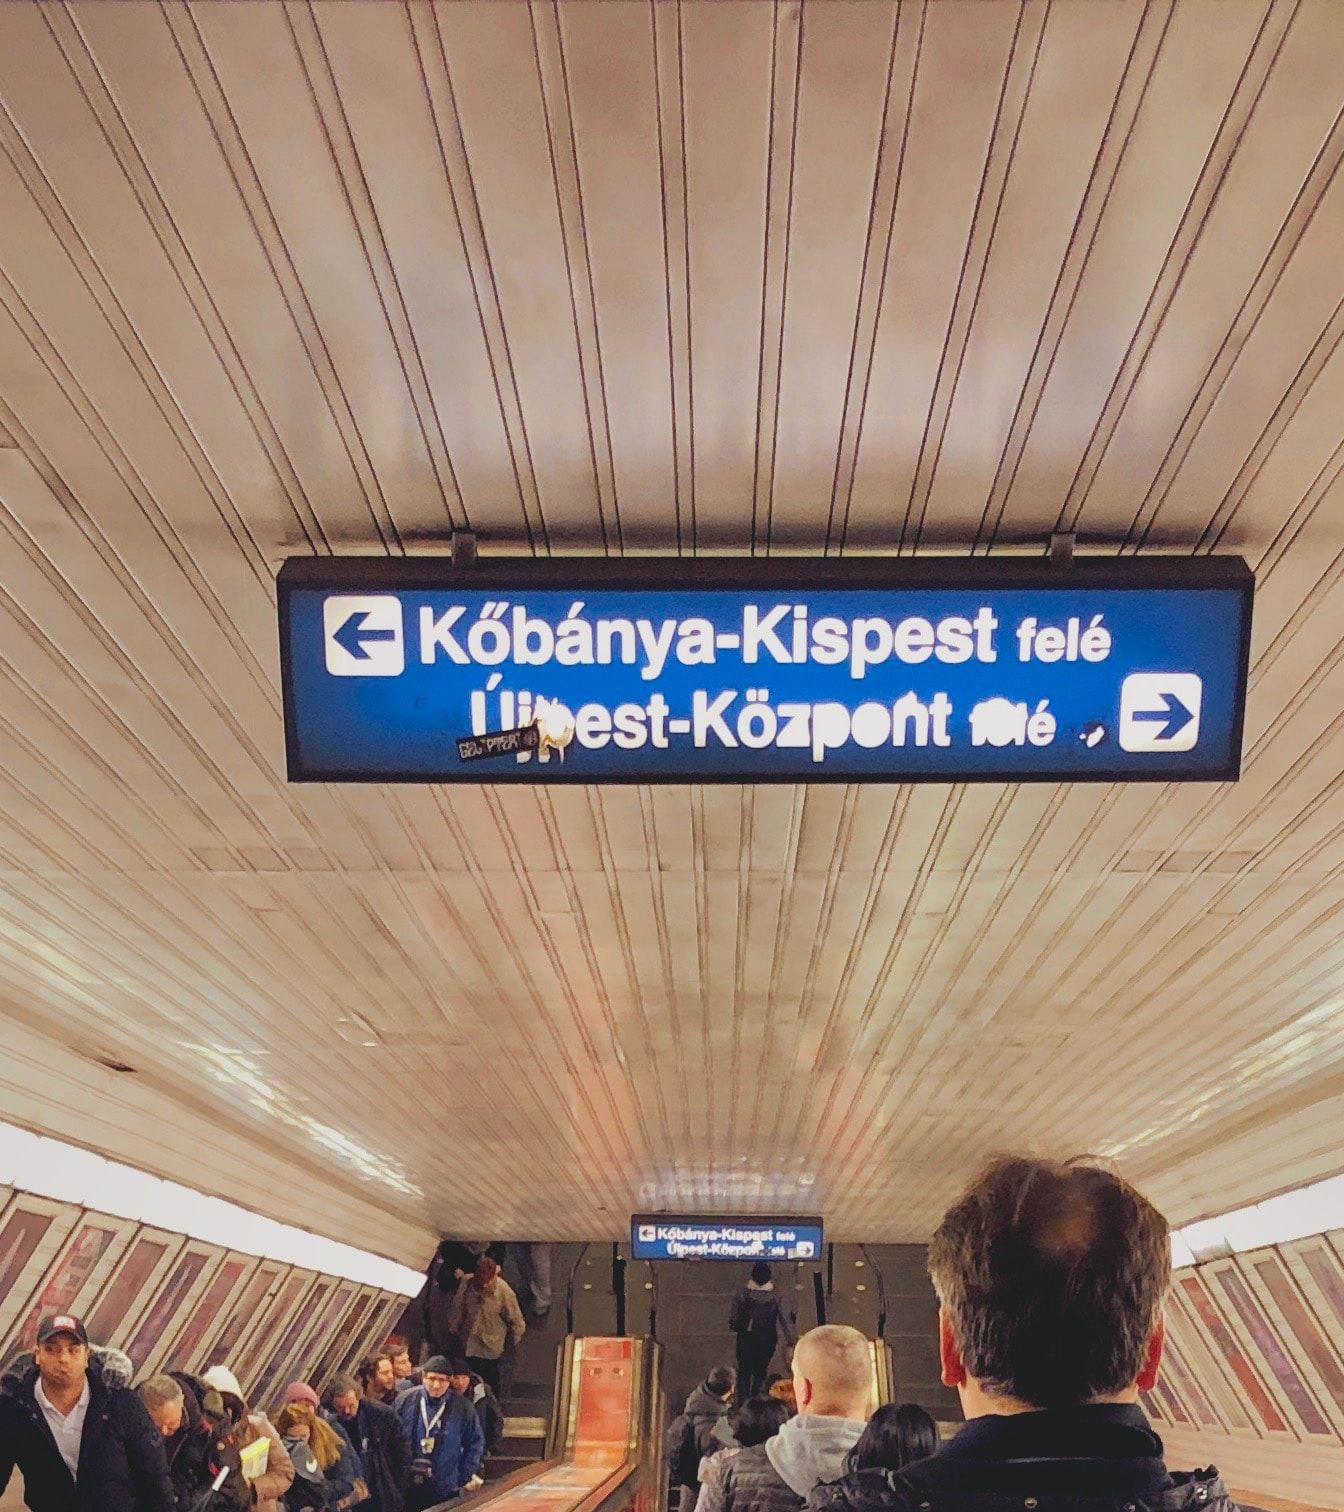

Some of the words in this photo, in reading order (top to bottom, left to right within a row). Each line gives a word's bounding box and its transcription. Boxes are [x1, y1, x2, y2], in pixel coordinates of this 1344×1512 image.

[418, 602, 997, 679] Kőbánya-Kispest
[1017, 614, 1111, 665] felé
[657, 1227, 773, 1243] Kőbánya-Kispest
